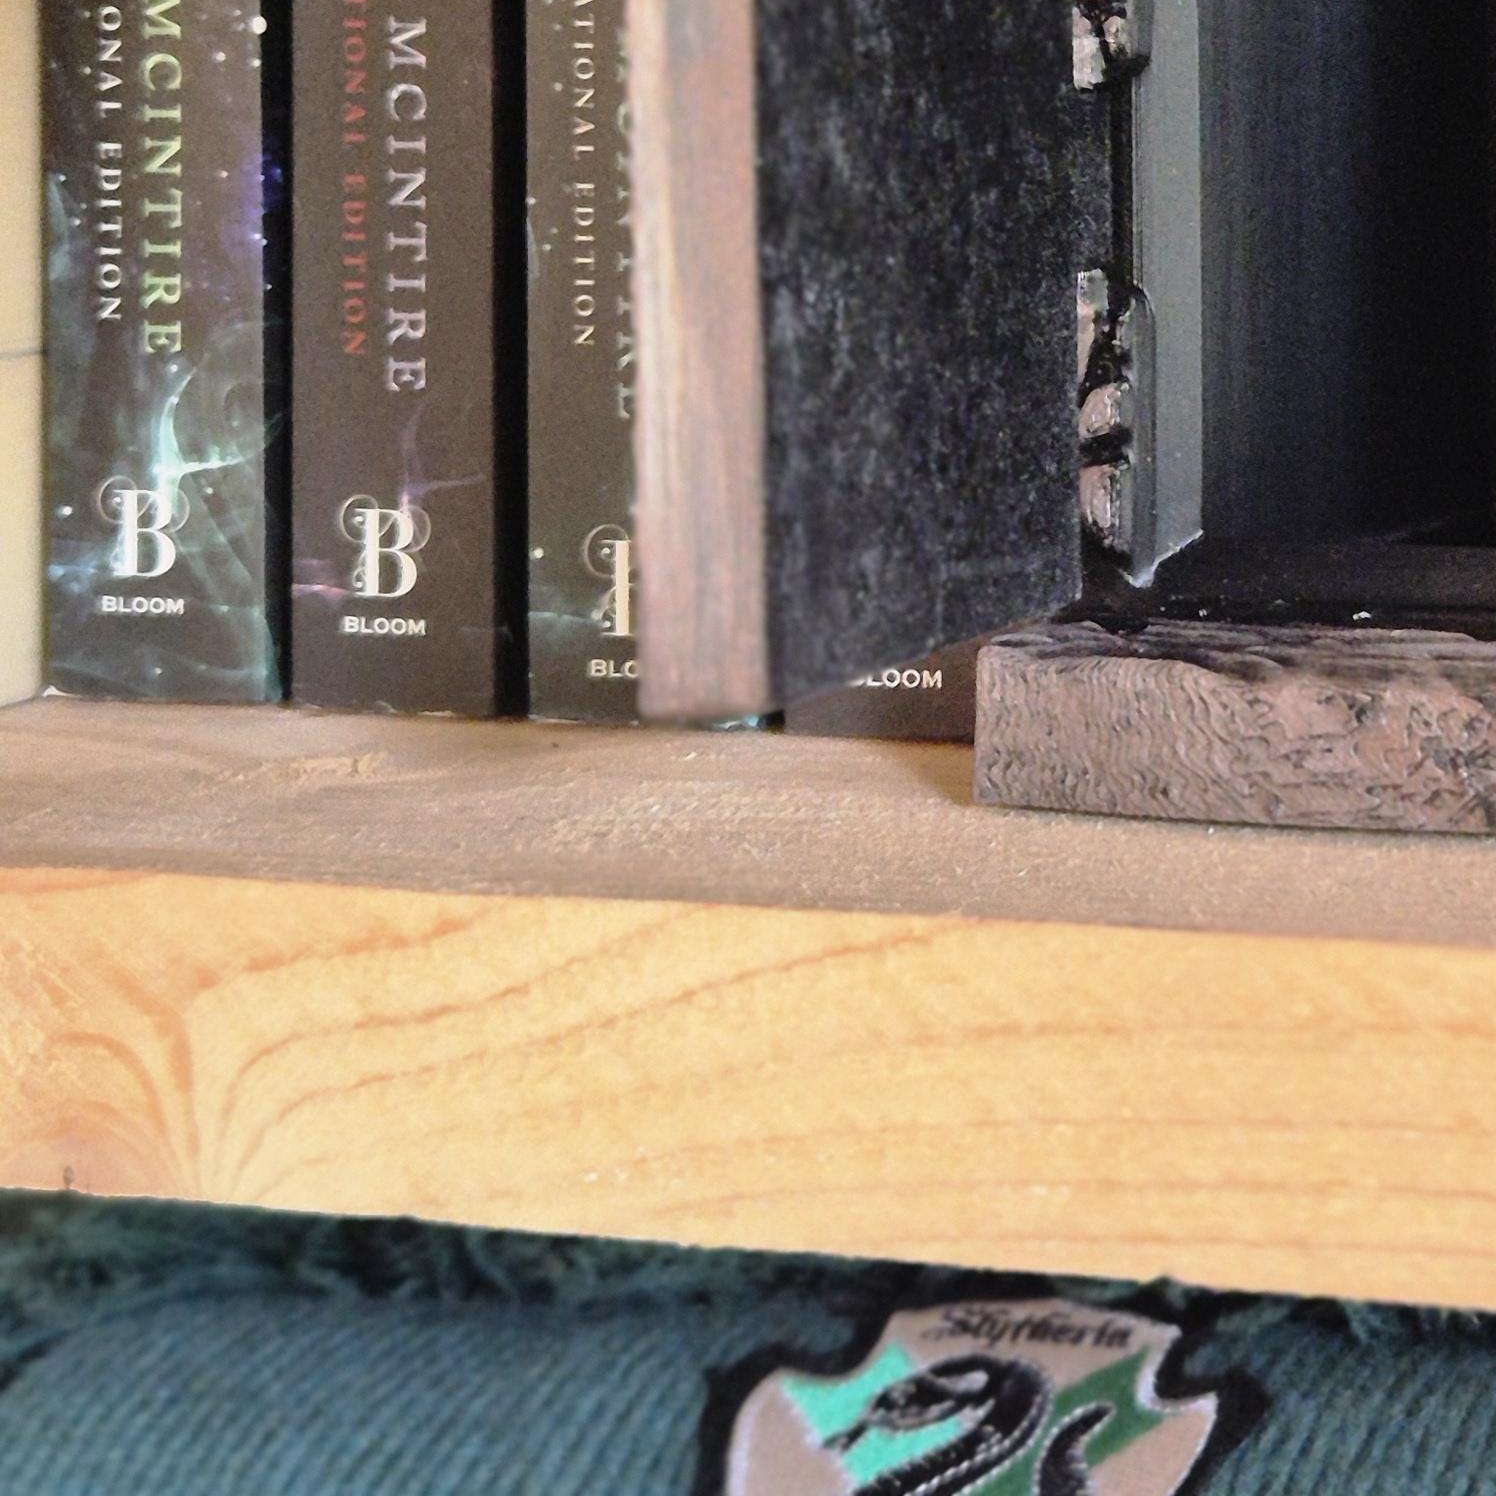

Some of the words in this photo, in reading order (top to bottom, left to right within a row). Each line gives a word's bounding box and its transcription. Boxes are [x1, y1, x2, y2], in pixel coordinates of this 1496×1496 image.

[99, 143, 122, 321] EDITION
[386, 16, 427, 392] MCINTIRE
[344, 174, 367, 357] EDITION
[573, 182, 594, 346] EDITION
[101, 595, 185, 616] BLOOM
[343, 615, 427, 637] BLOOM
[590, 659, 639, 679] BLO
[846, 668, 943, 688] LOOM
